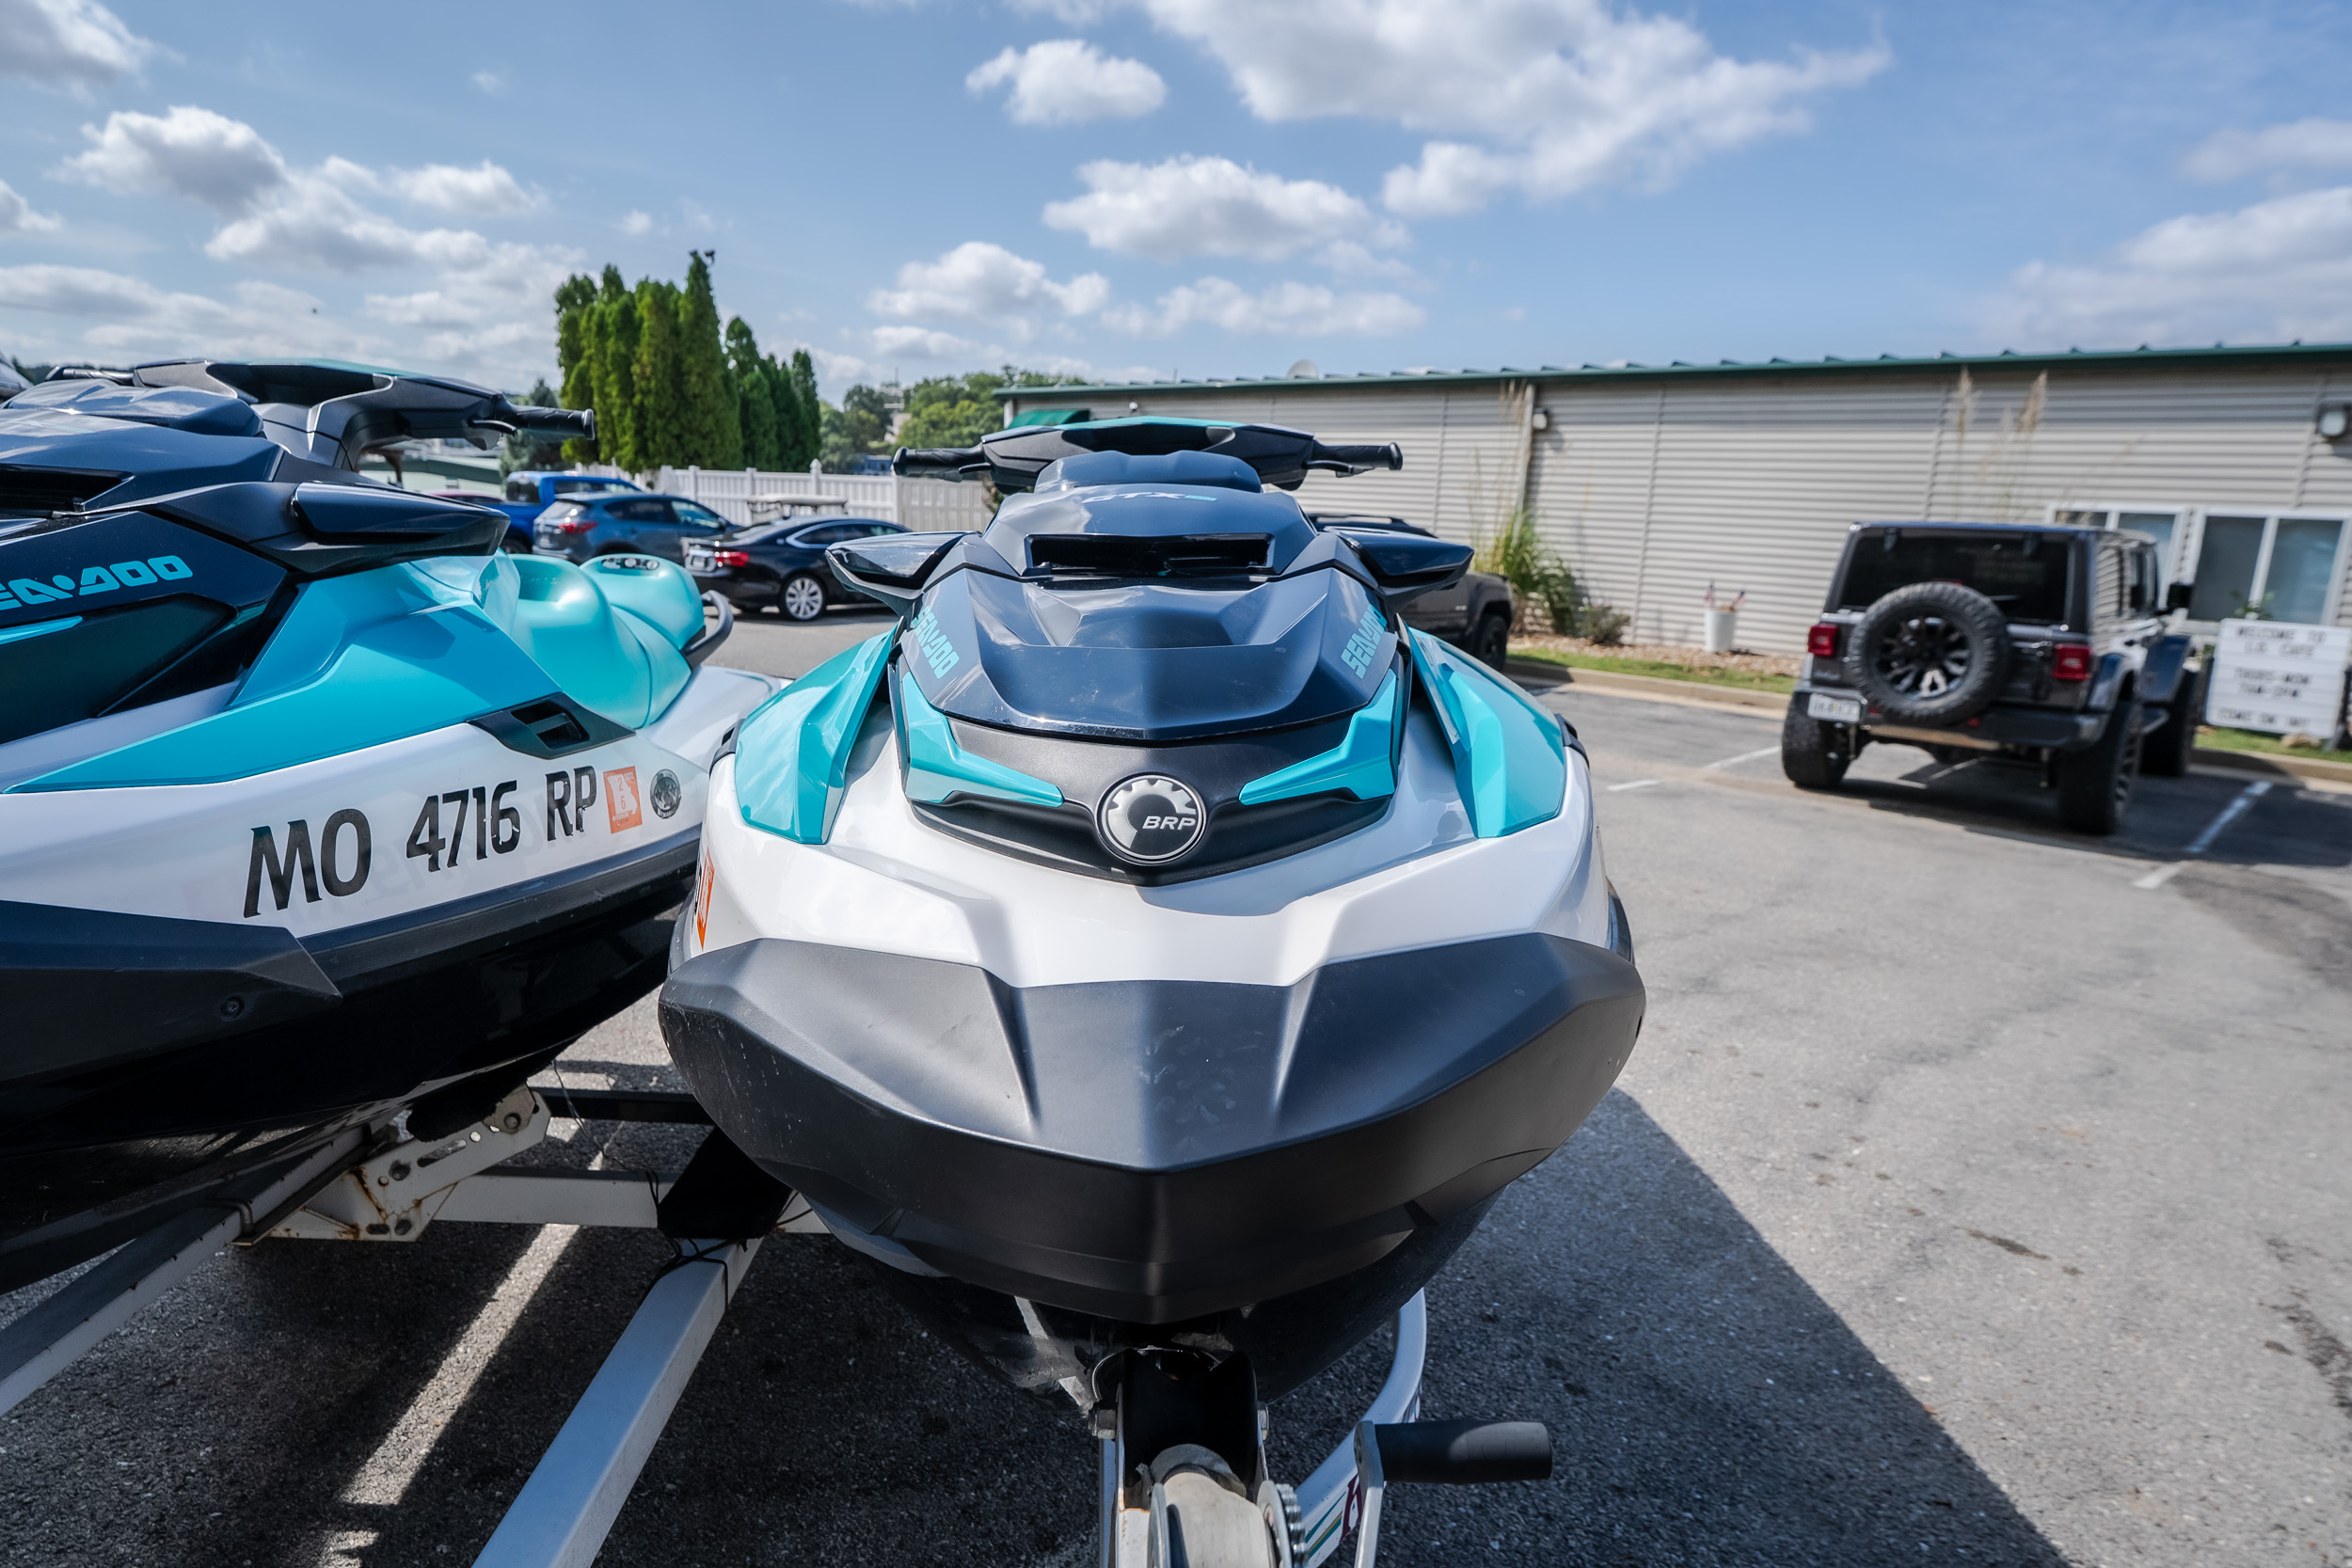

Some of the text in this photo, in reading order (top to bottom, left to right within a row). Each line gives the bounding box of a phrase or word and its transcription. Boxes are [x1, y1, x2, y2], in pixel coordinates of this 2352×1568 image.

[1082, 491, 1185, 504] GTX
[0, 555, 194, 610] EA-DOO
[1141, 816, 1197, 831] BRP
[243, 765, 597, 919] MO 4716 RP
